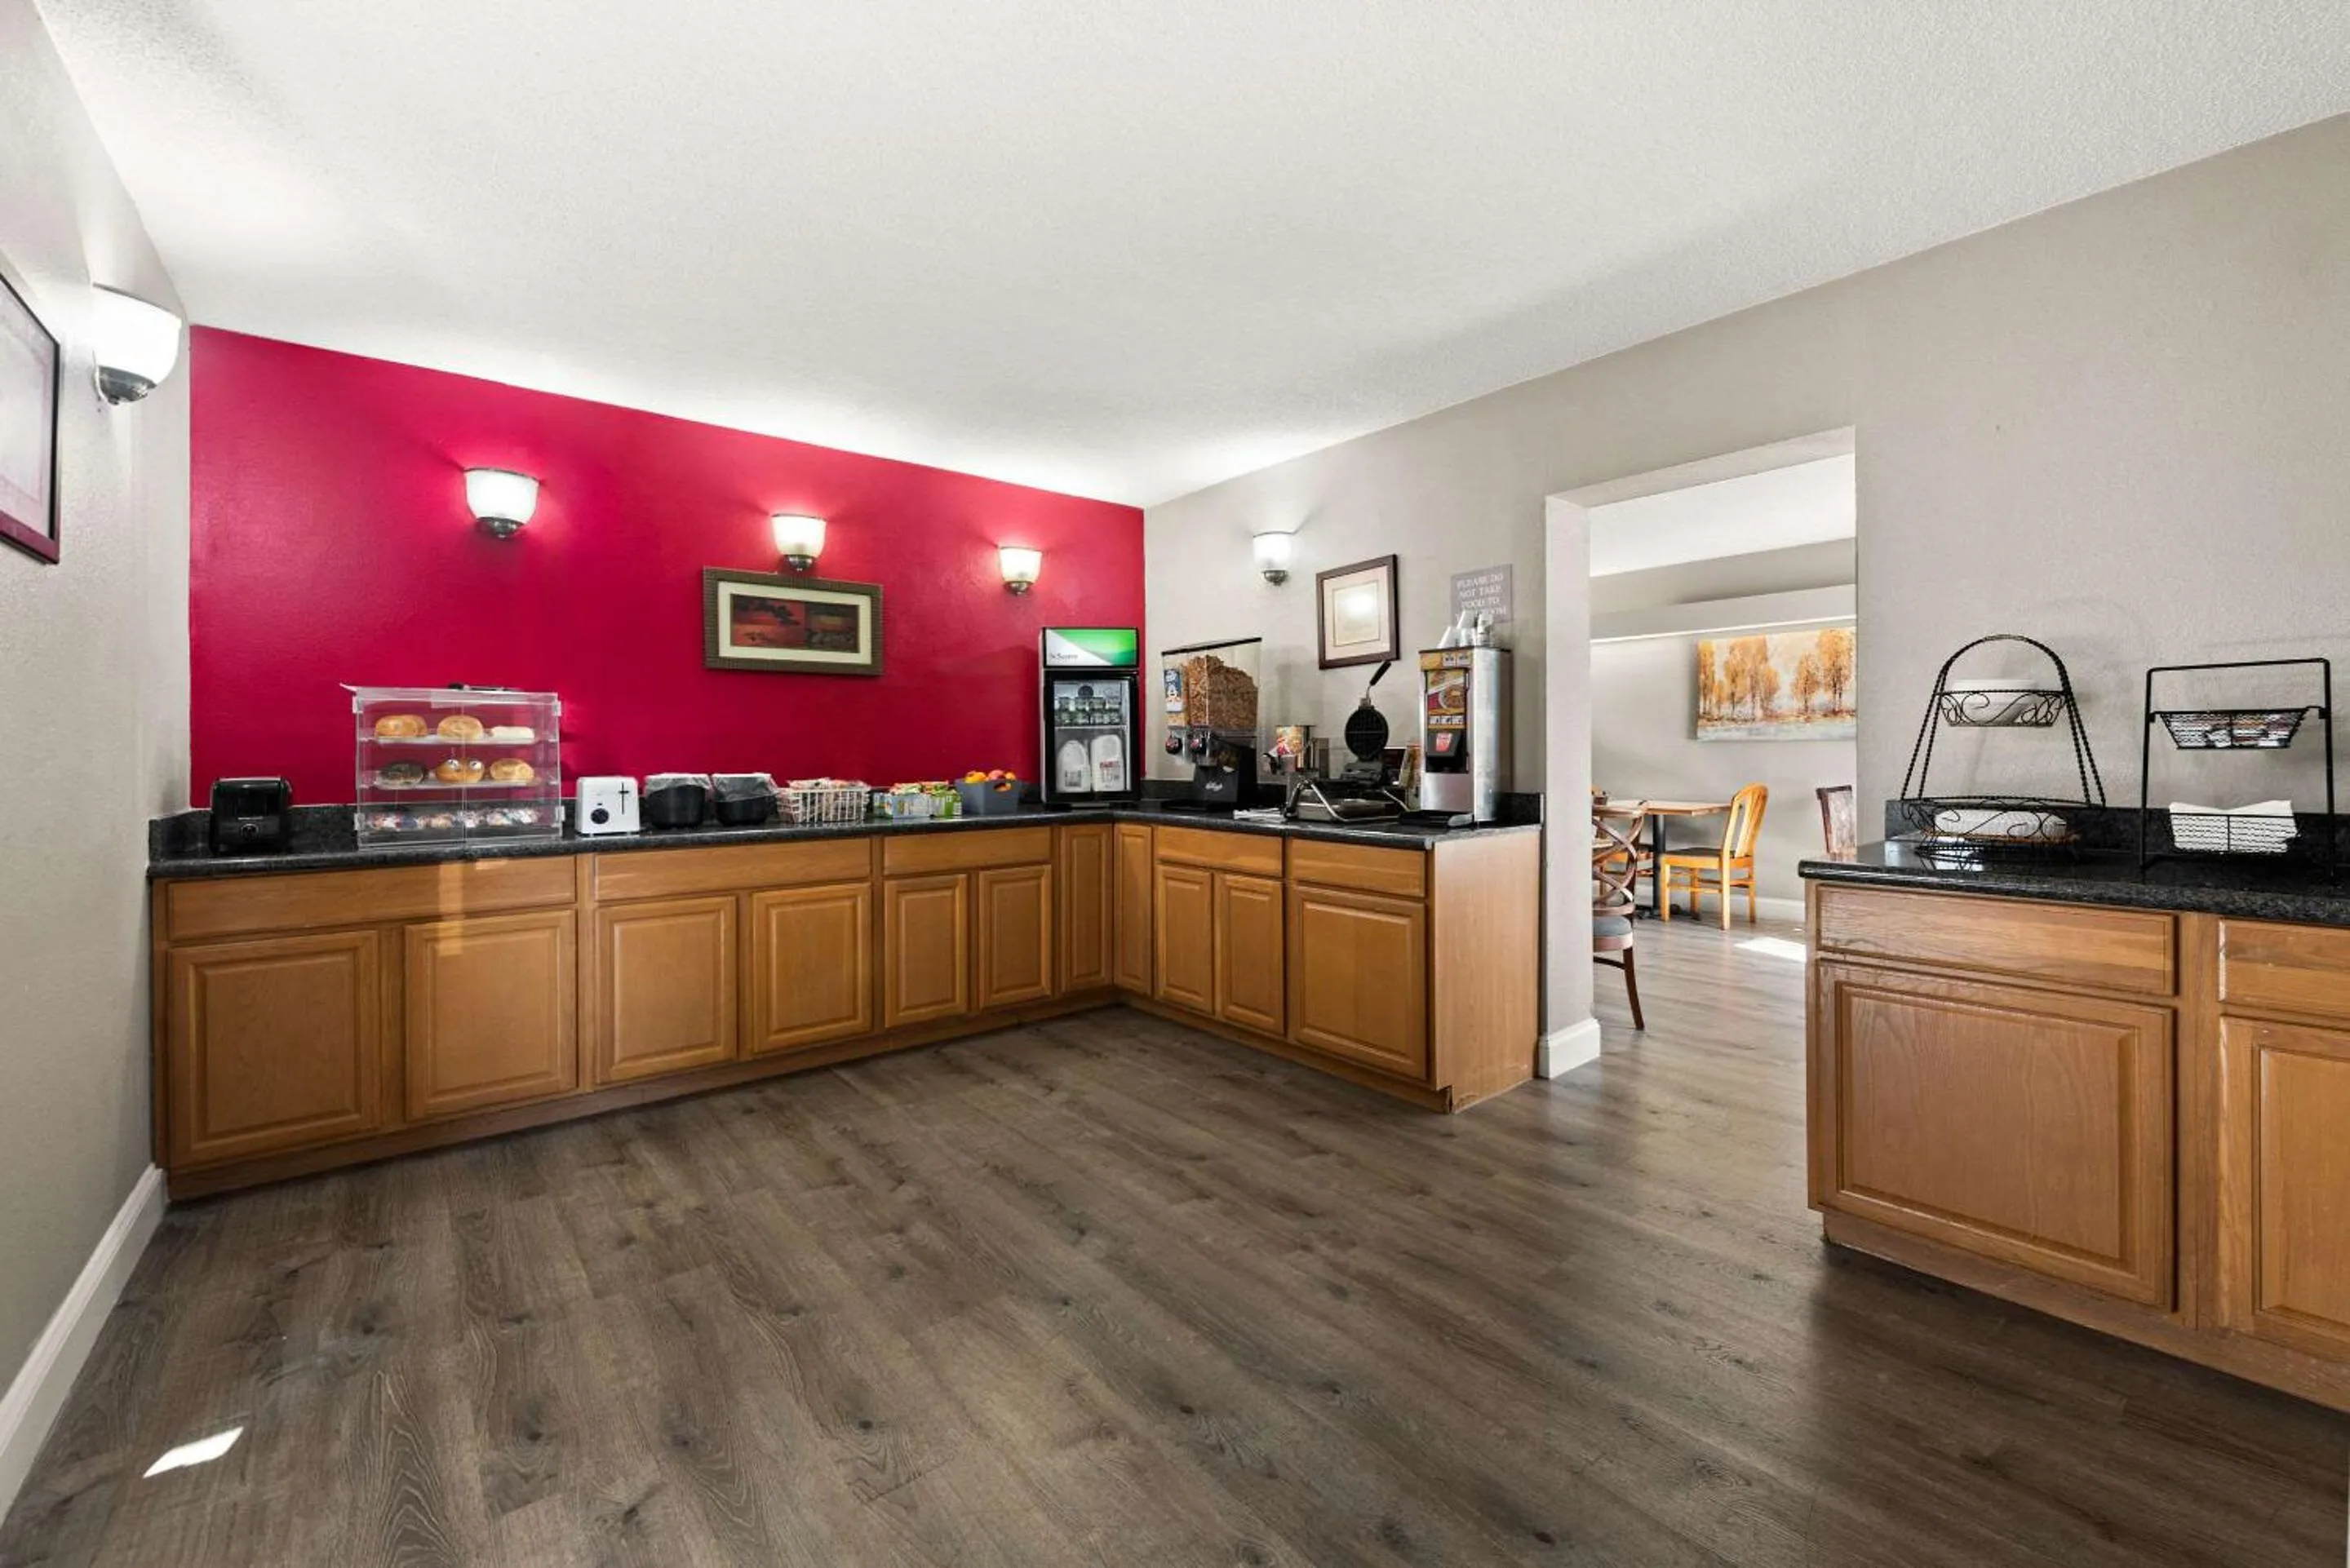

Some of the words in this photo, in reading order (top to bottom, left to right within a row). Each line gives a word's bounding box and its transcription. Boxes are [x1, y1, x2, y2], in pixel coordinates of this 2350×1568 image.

[1491, 573, 1504, 582] DO
[1459, 588, 1476, 598] NOT
[1479, 585, 1501, 596] TAKE
[1488, 596, 1501, 605] TO
